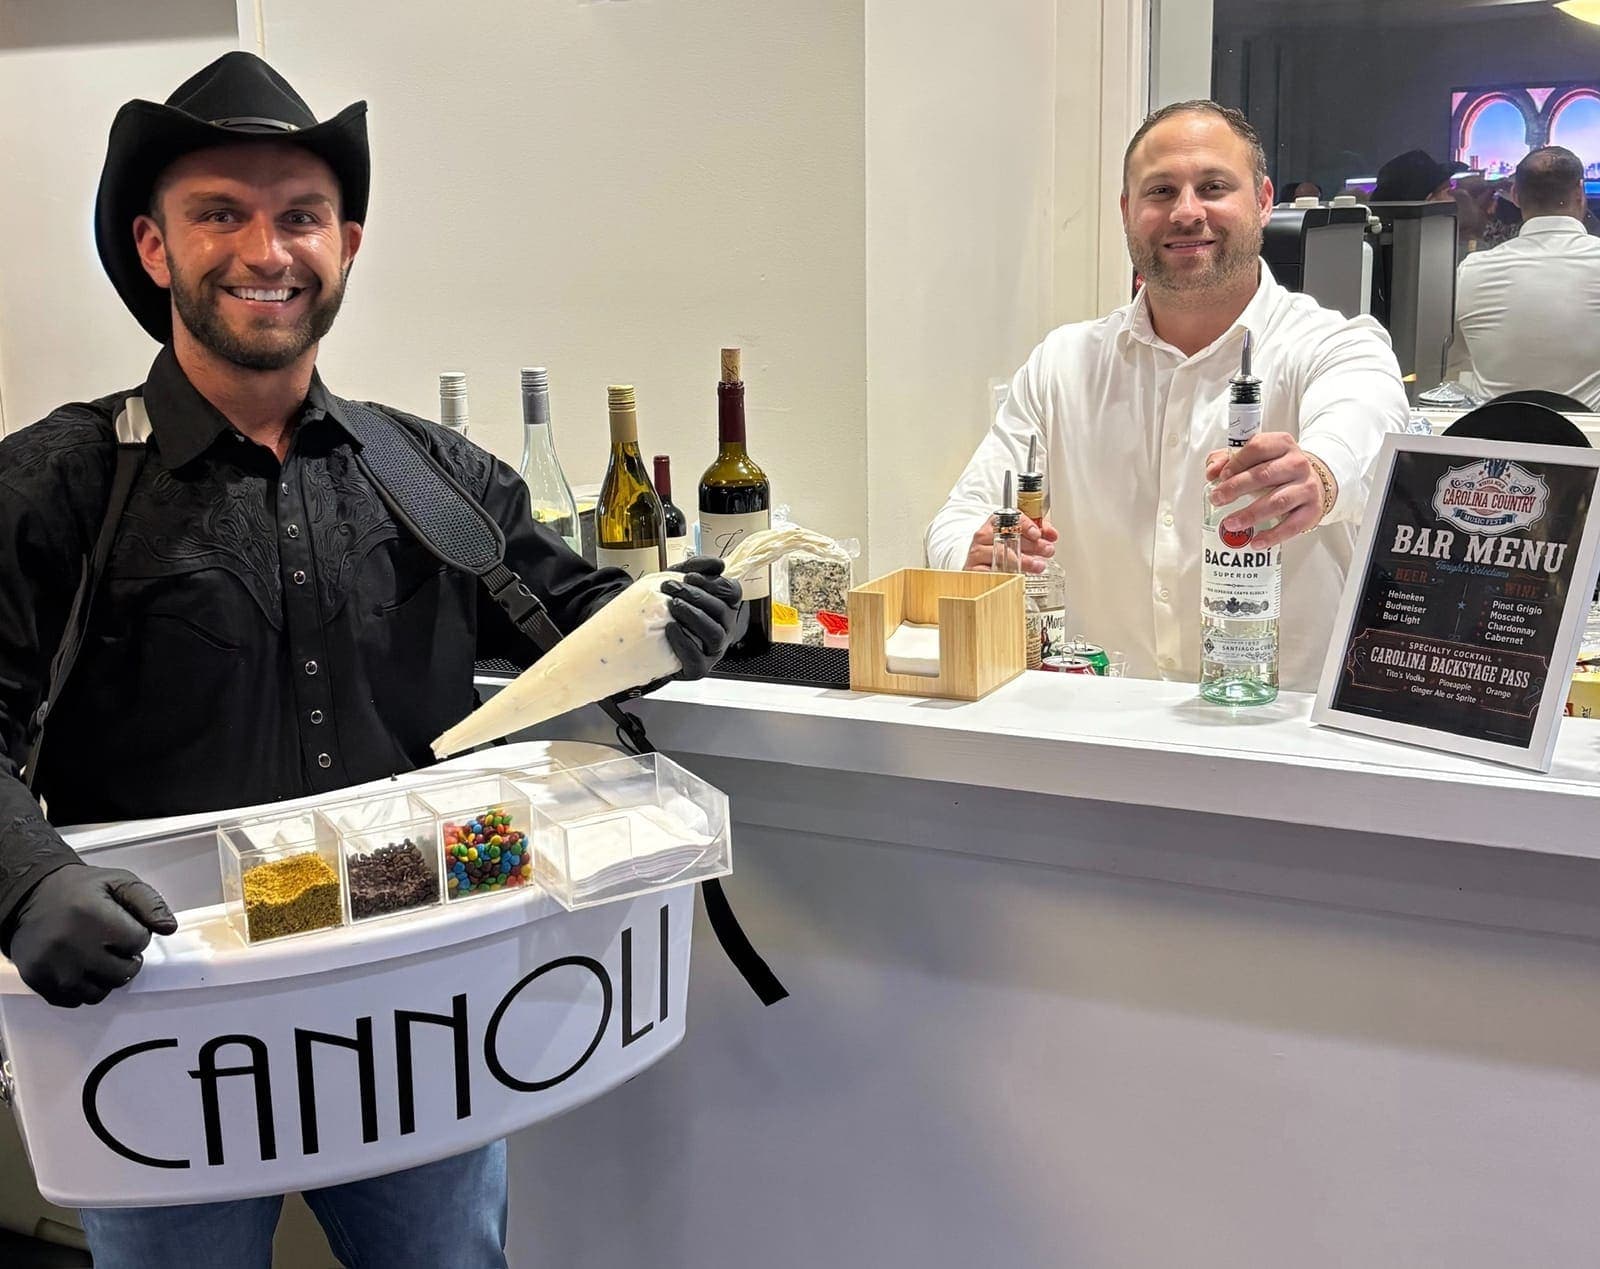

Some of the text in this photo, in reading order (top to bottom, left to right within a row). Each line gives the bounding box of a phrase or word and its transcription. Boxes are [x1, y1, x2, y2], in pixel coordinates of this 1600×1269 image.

[1443, 488, 1536, 513] CAROLINA COUNTRY
[1464, 514, 1485, 525] MUSIC
[1391, 524, 1568, 573] BAR MENU
[1213, 570, 1259, 579] SUPERIOR
[1394, 567, 1428, 584] BEER
[1471, 565, 1510, 579] Selections
[1388, 589, 1425, 602] Heineken
[1385, 600, 1427, 614] Budweiser
[1492, 600, 1543, 616] Pinot Grigio
[1382, 611, 1421, 625] Bud Light
[1490, 611, 1525, 623] Moscato
[1487, 621, 1536, 637] Chardonnay
[1484, 632, 1524, 645] Cabernet
[1409, 641, 1493, 663] SPECIALTY COCKTAIL
[1370, 646, 1531, 689] CAROLINA BACKSTAGE PASS
[1386, 668, 1512, 699] Tito's Vodka Pineapple Orange
[1410, 685, 1433, 696] Ginger
[1434, 689, 1446, 698] Ale
[1456, 693, 1477, 704] Sprite
[81, 903, 670, 1169] CANNOLI
